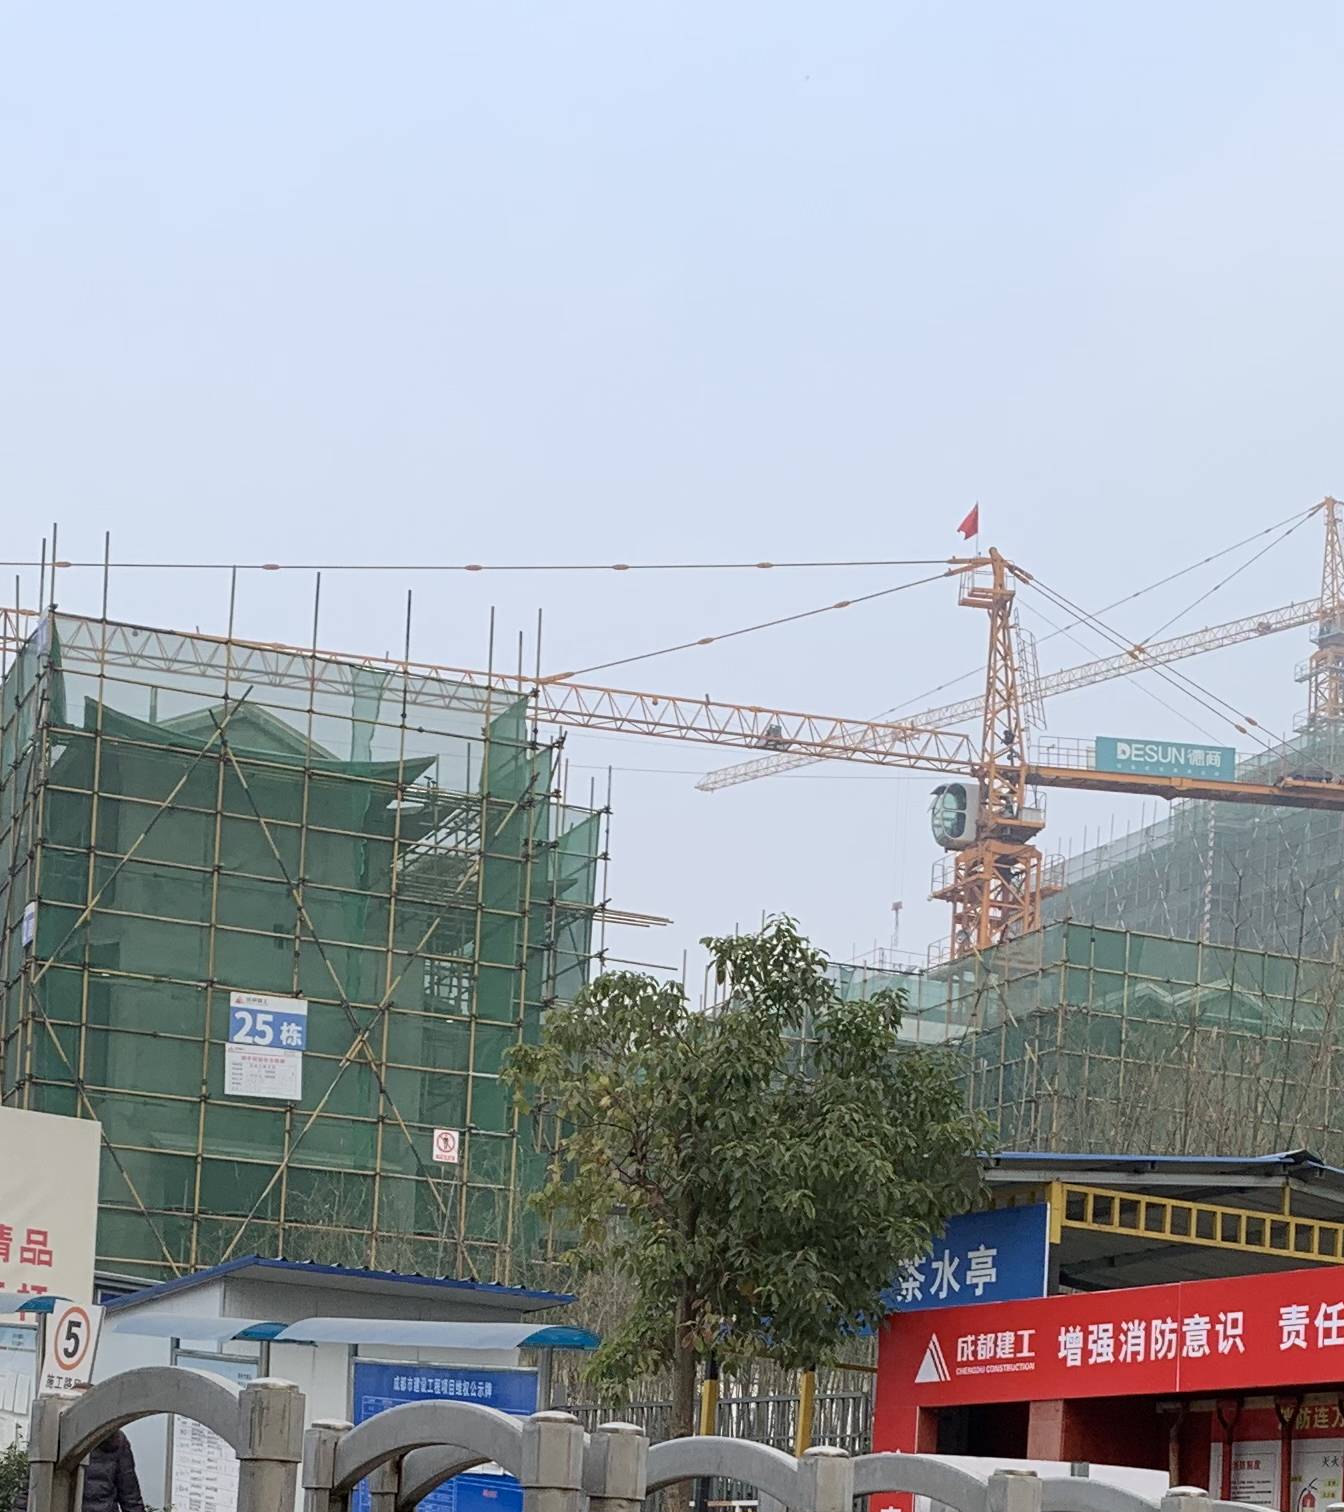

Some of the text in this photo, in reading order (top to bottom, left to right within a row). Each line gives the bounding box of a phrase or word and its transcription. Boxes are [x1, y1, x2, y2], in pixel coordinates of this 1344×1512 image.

[1116, 742, 1185, 765] DESUN
[897, 1243, 998, 1302] 茶水亭
[63, 1319, 82, 1359] 5
[956, 1329, 1036, 1362] 成都建工
[1058, 1311, 1246, 1368] 增强消防意识
[956, 1361, 1036, 1376] CHENGDU CONSTRUCTION
